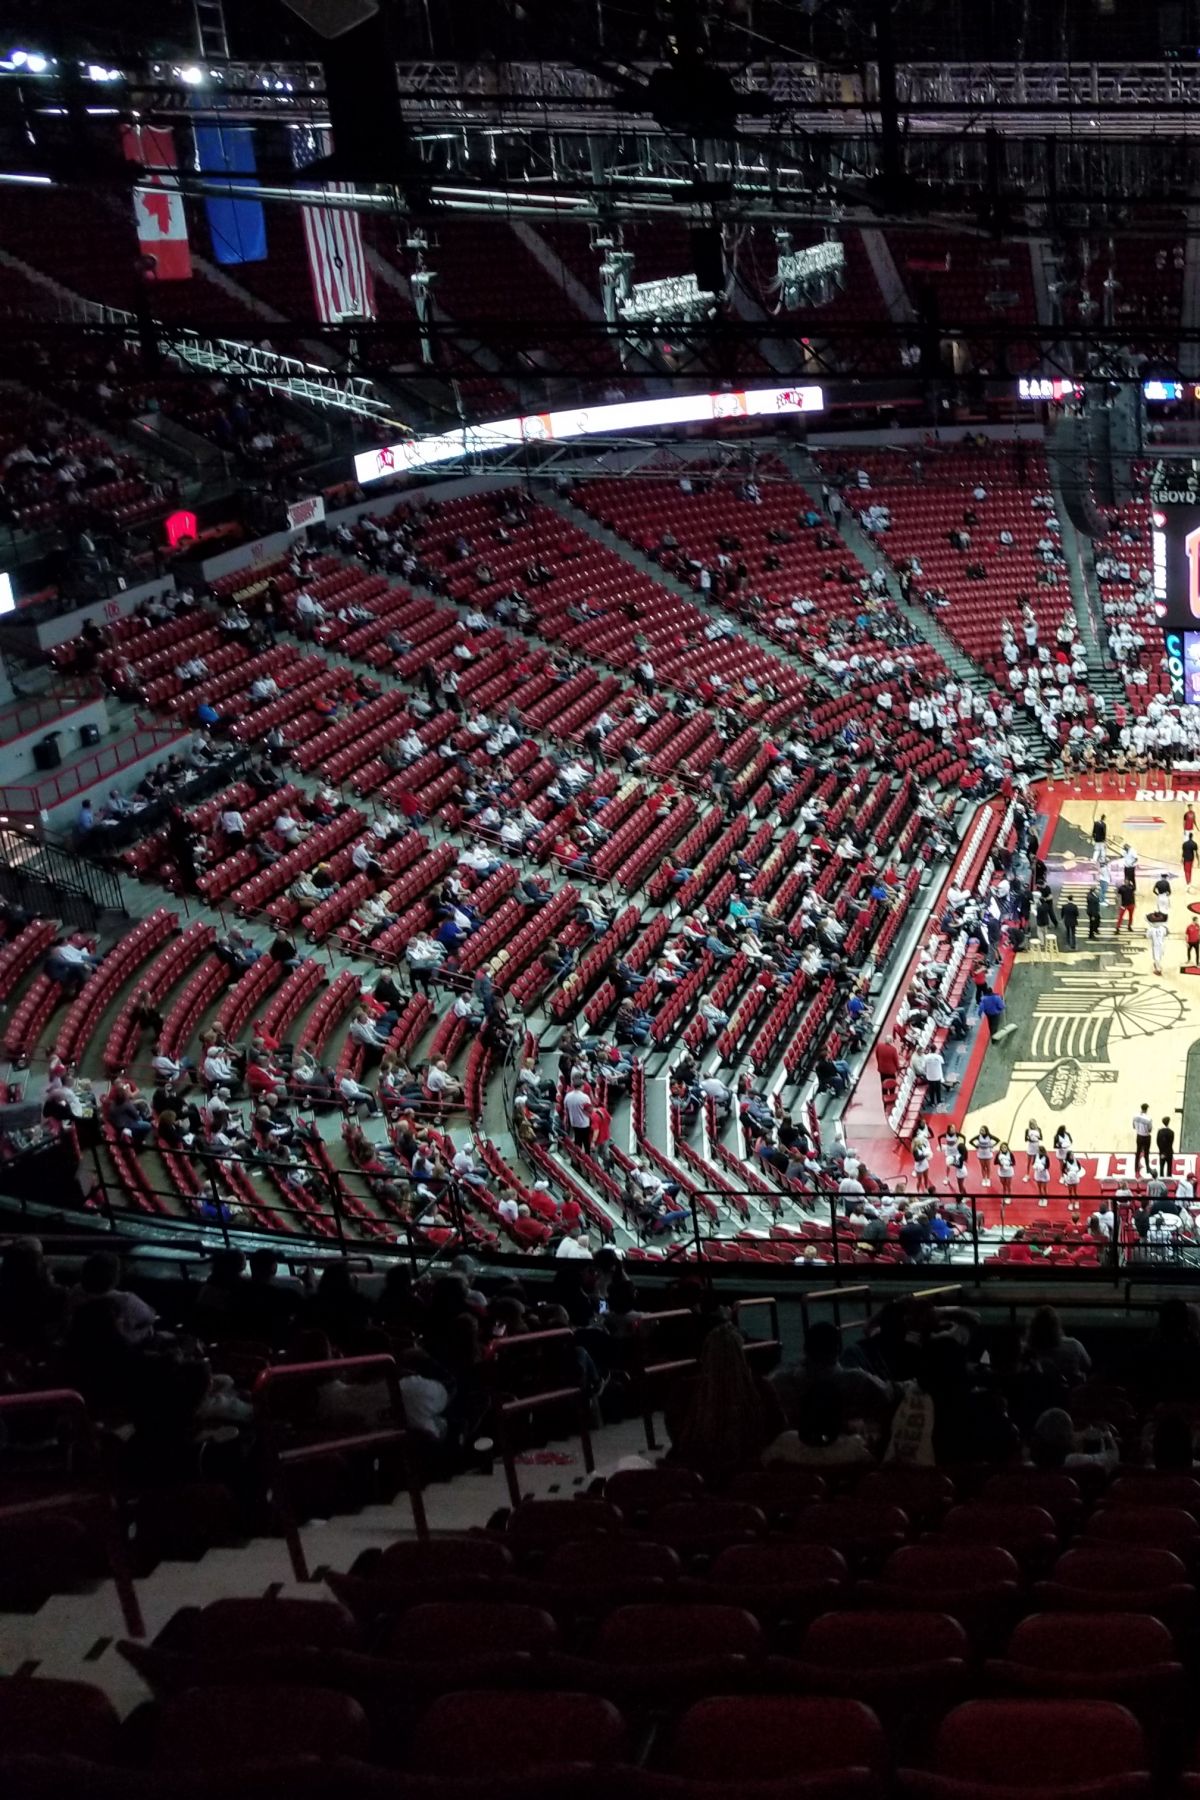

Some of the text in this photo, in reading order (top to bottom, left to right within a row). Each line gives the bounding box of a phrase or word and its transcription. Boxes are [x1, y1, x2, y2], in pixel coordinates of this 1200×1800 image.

[1158, 490, 1196, 504] BOYD
[1166, 634, 1184, 695] COX
[1049, 1080, 1067, 1106] VEGAS
